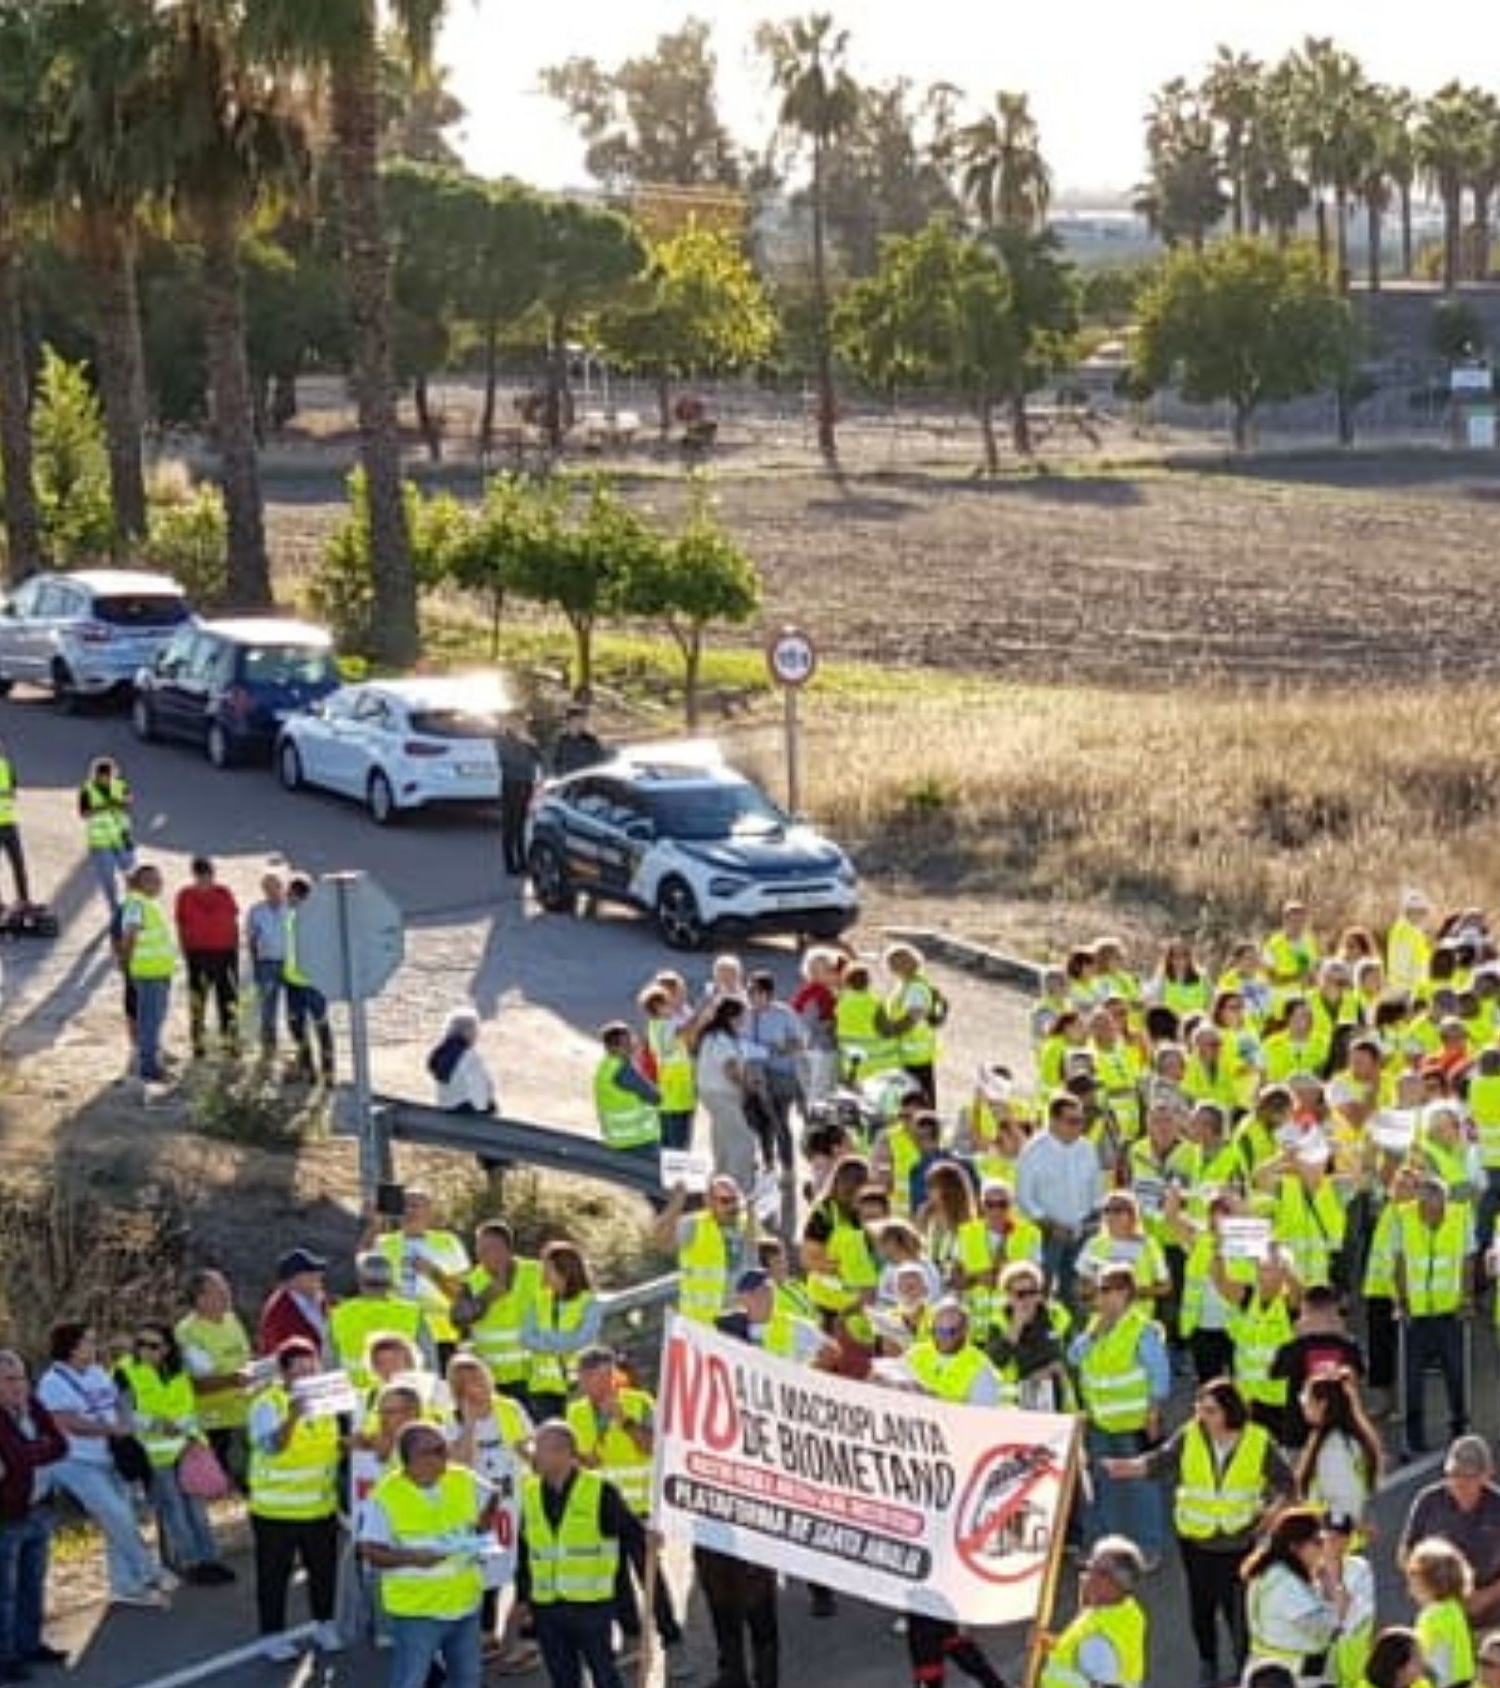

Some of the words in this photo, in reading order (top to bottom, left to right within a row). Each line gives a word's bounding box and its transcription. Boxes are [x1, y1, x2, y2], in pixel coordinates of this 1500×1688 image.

[663, 1337, 740, 1450] NO
[735, 1365, 748, 1401] A
[750, 1370, 775, 1412] LA
[779, 1383, 951, 1455] MACROPLANTA
[740, 1409, 776, 1464] DE
[777, 1422, 956, 1512] BIOMETANO
